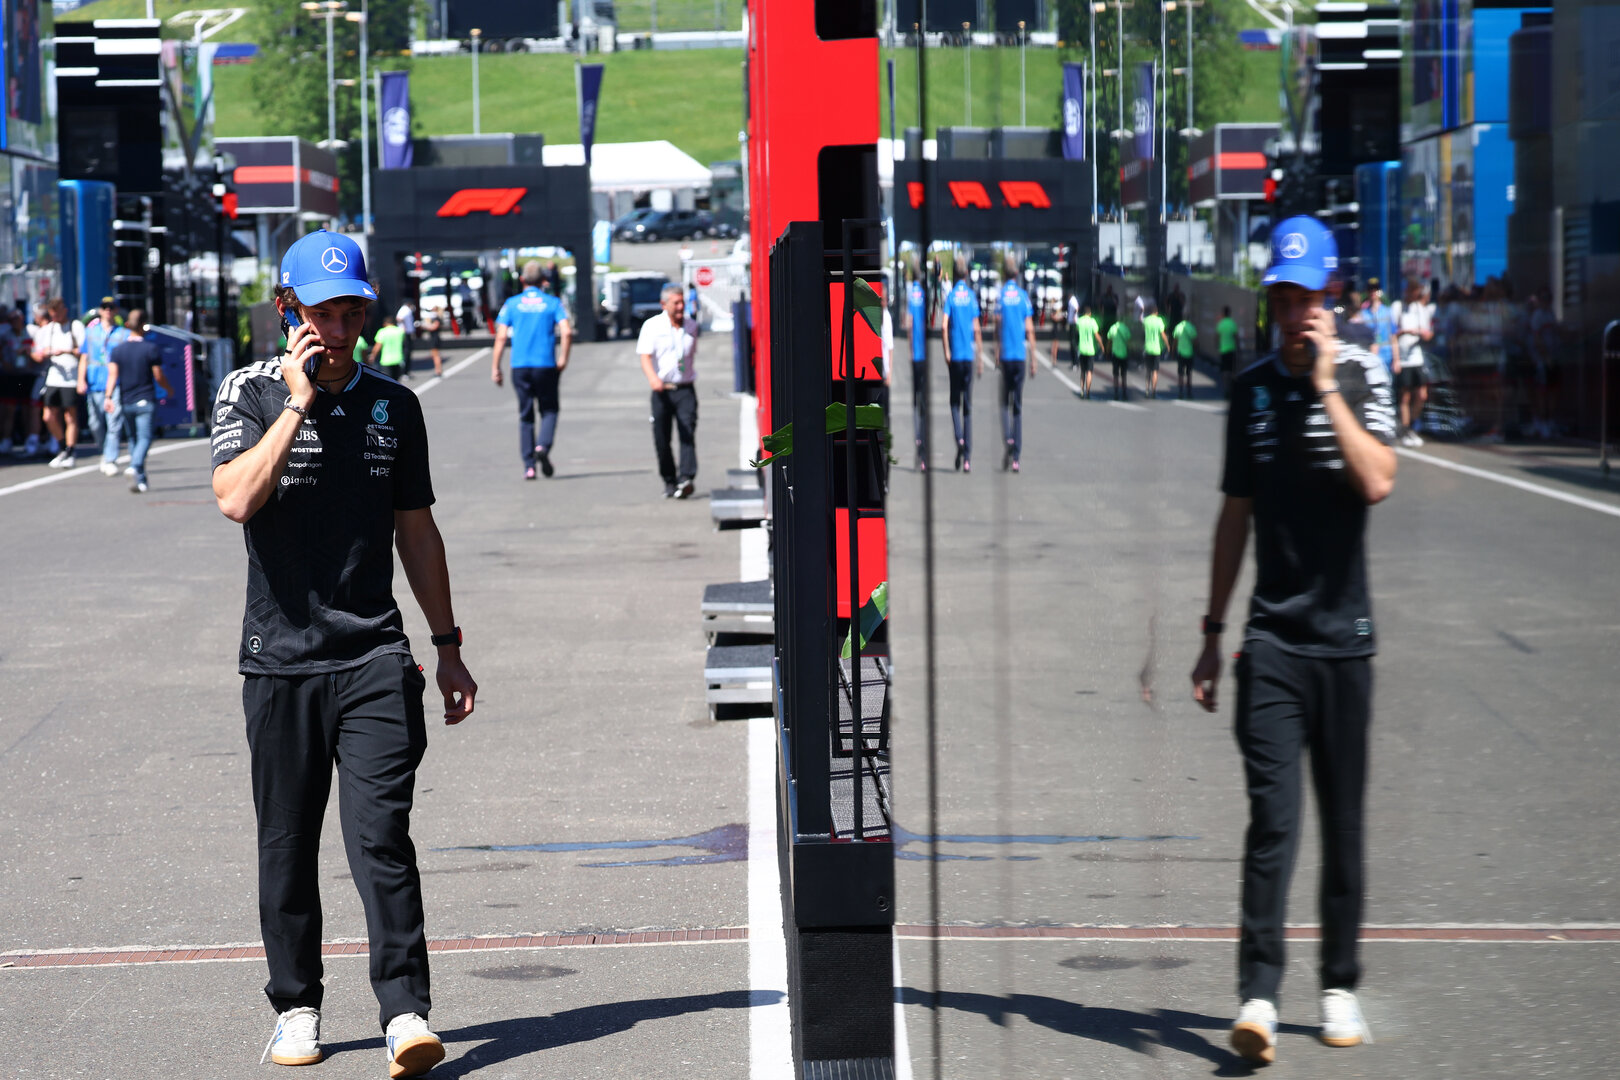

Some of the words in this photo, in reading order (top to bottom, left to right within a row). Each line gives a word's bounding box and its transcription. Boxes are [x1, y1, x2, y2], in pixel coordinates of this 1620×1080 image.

[436, 187, 528, 217] F1
[365, 435, 398, 449] INEOS
[370, 466, 391, 477] HPE
